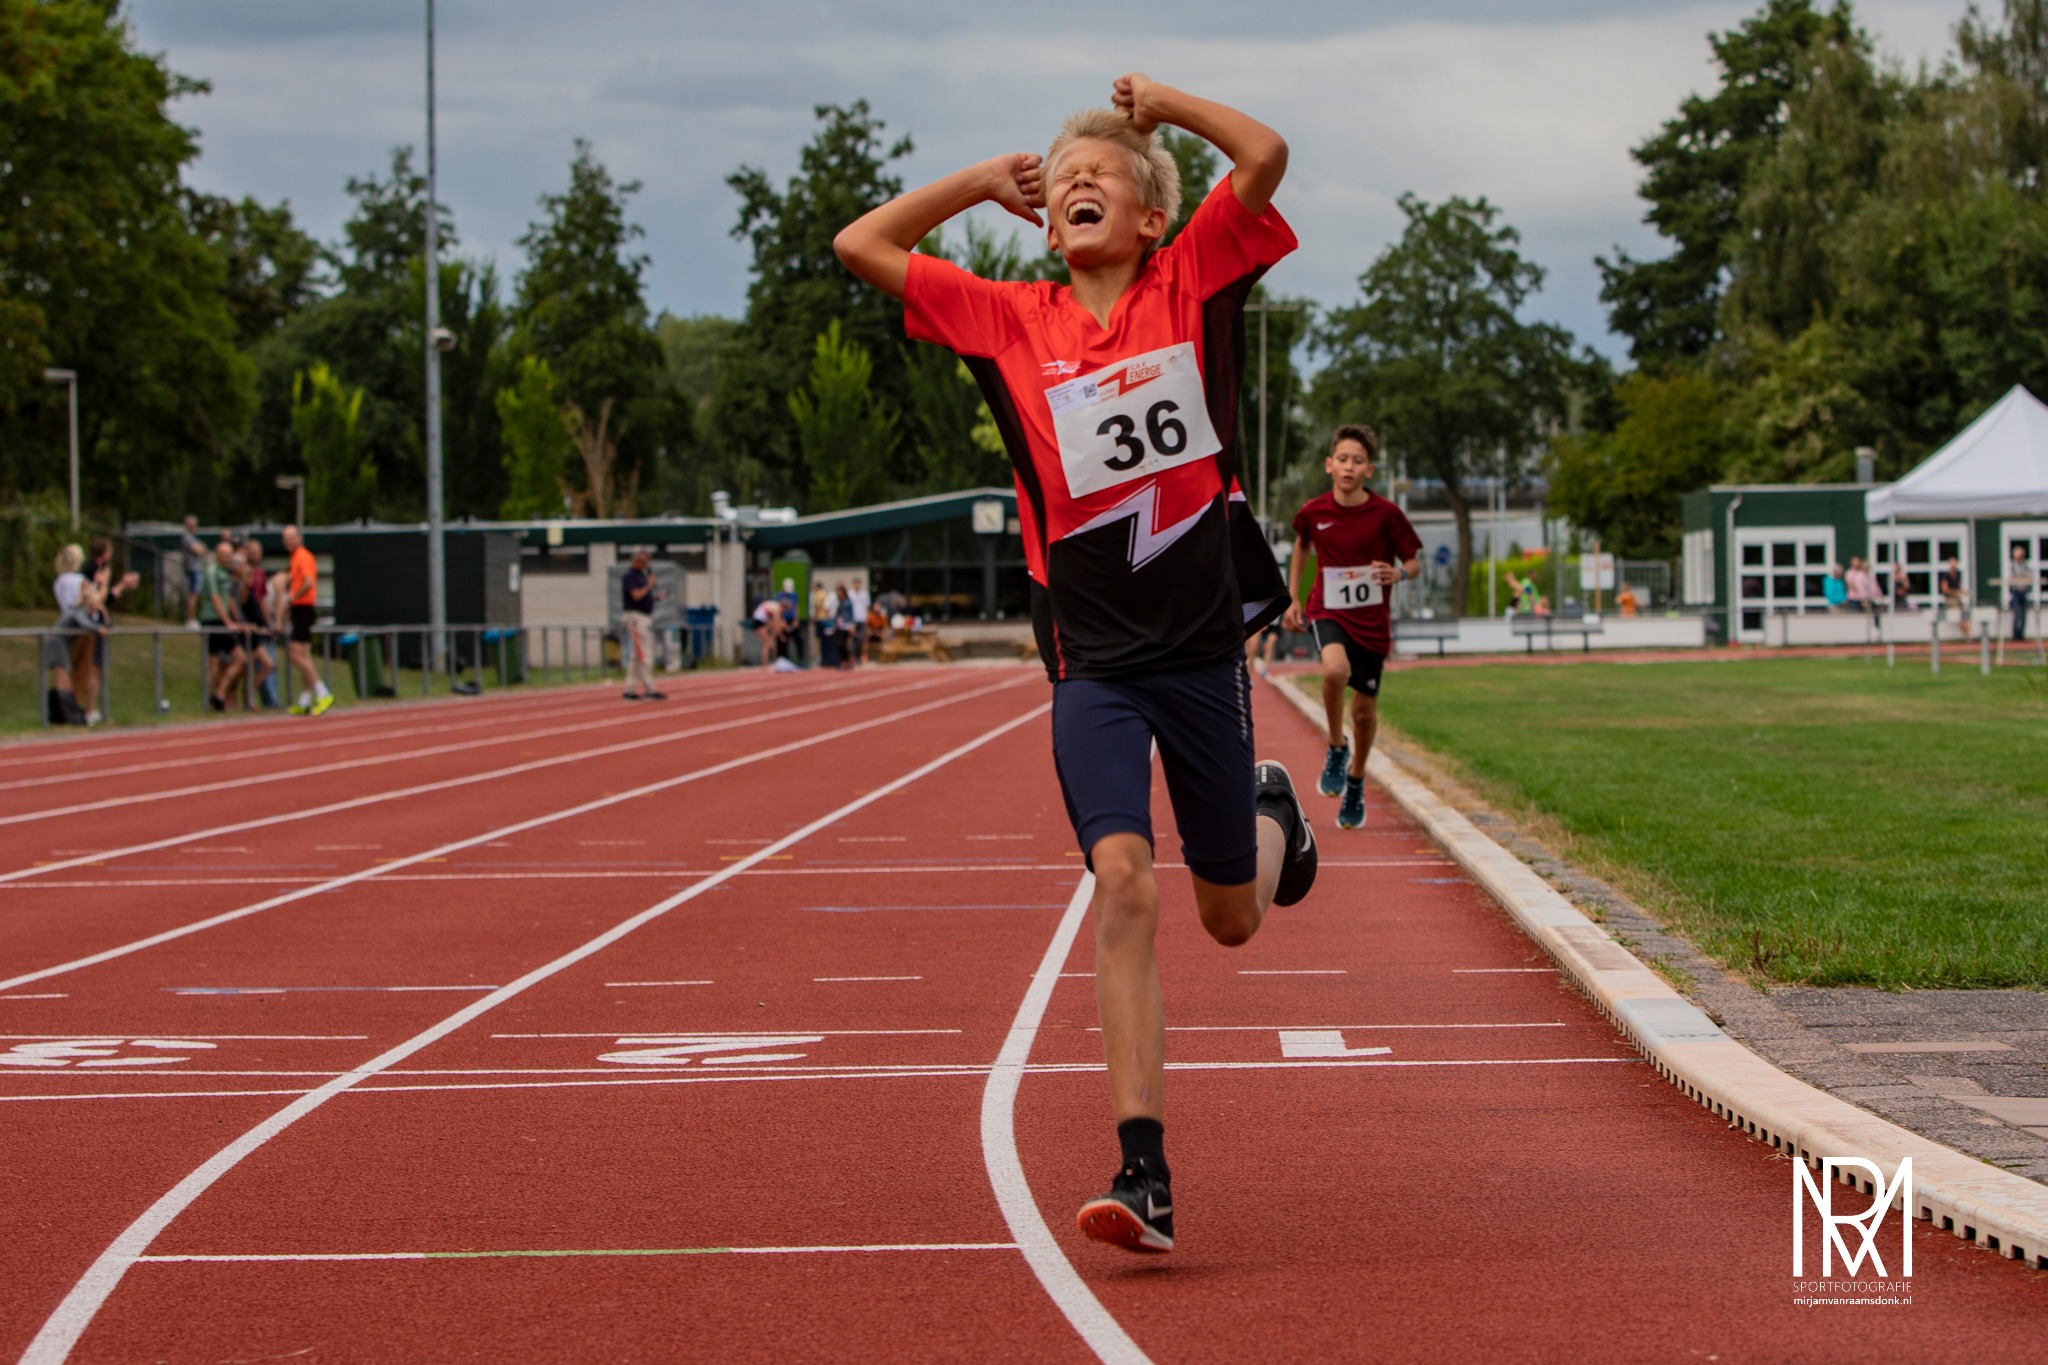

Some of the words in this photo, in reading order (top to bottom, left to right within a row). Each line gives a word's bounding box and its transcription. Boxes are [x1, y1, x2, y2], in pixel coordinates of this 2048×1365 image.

[1130, 364, 1161, 382] ENERGIE
[1096, 400, 1187, 471] 36
[1340, 583, 1369, 604] 10
[597, 1036, 825, 1065] 2
